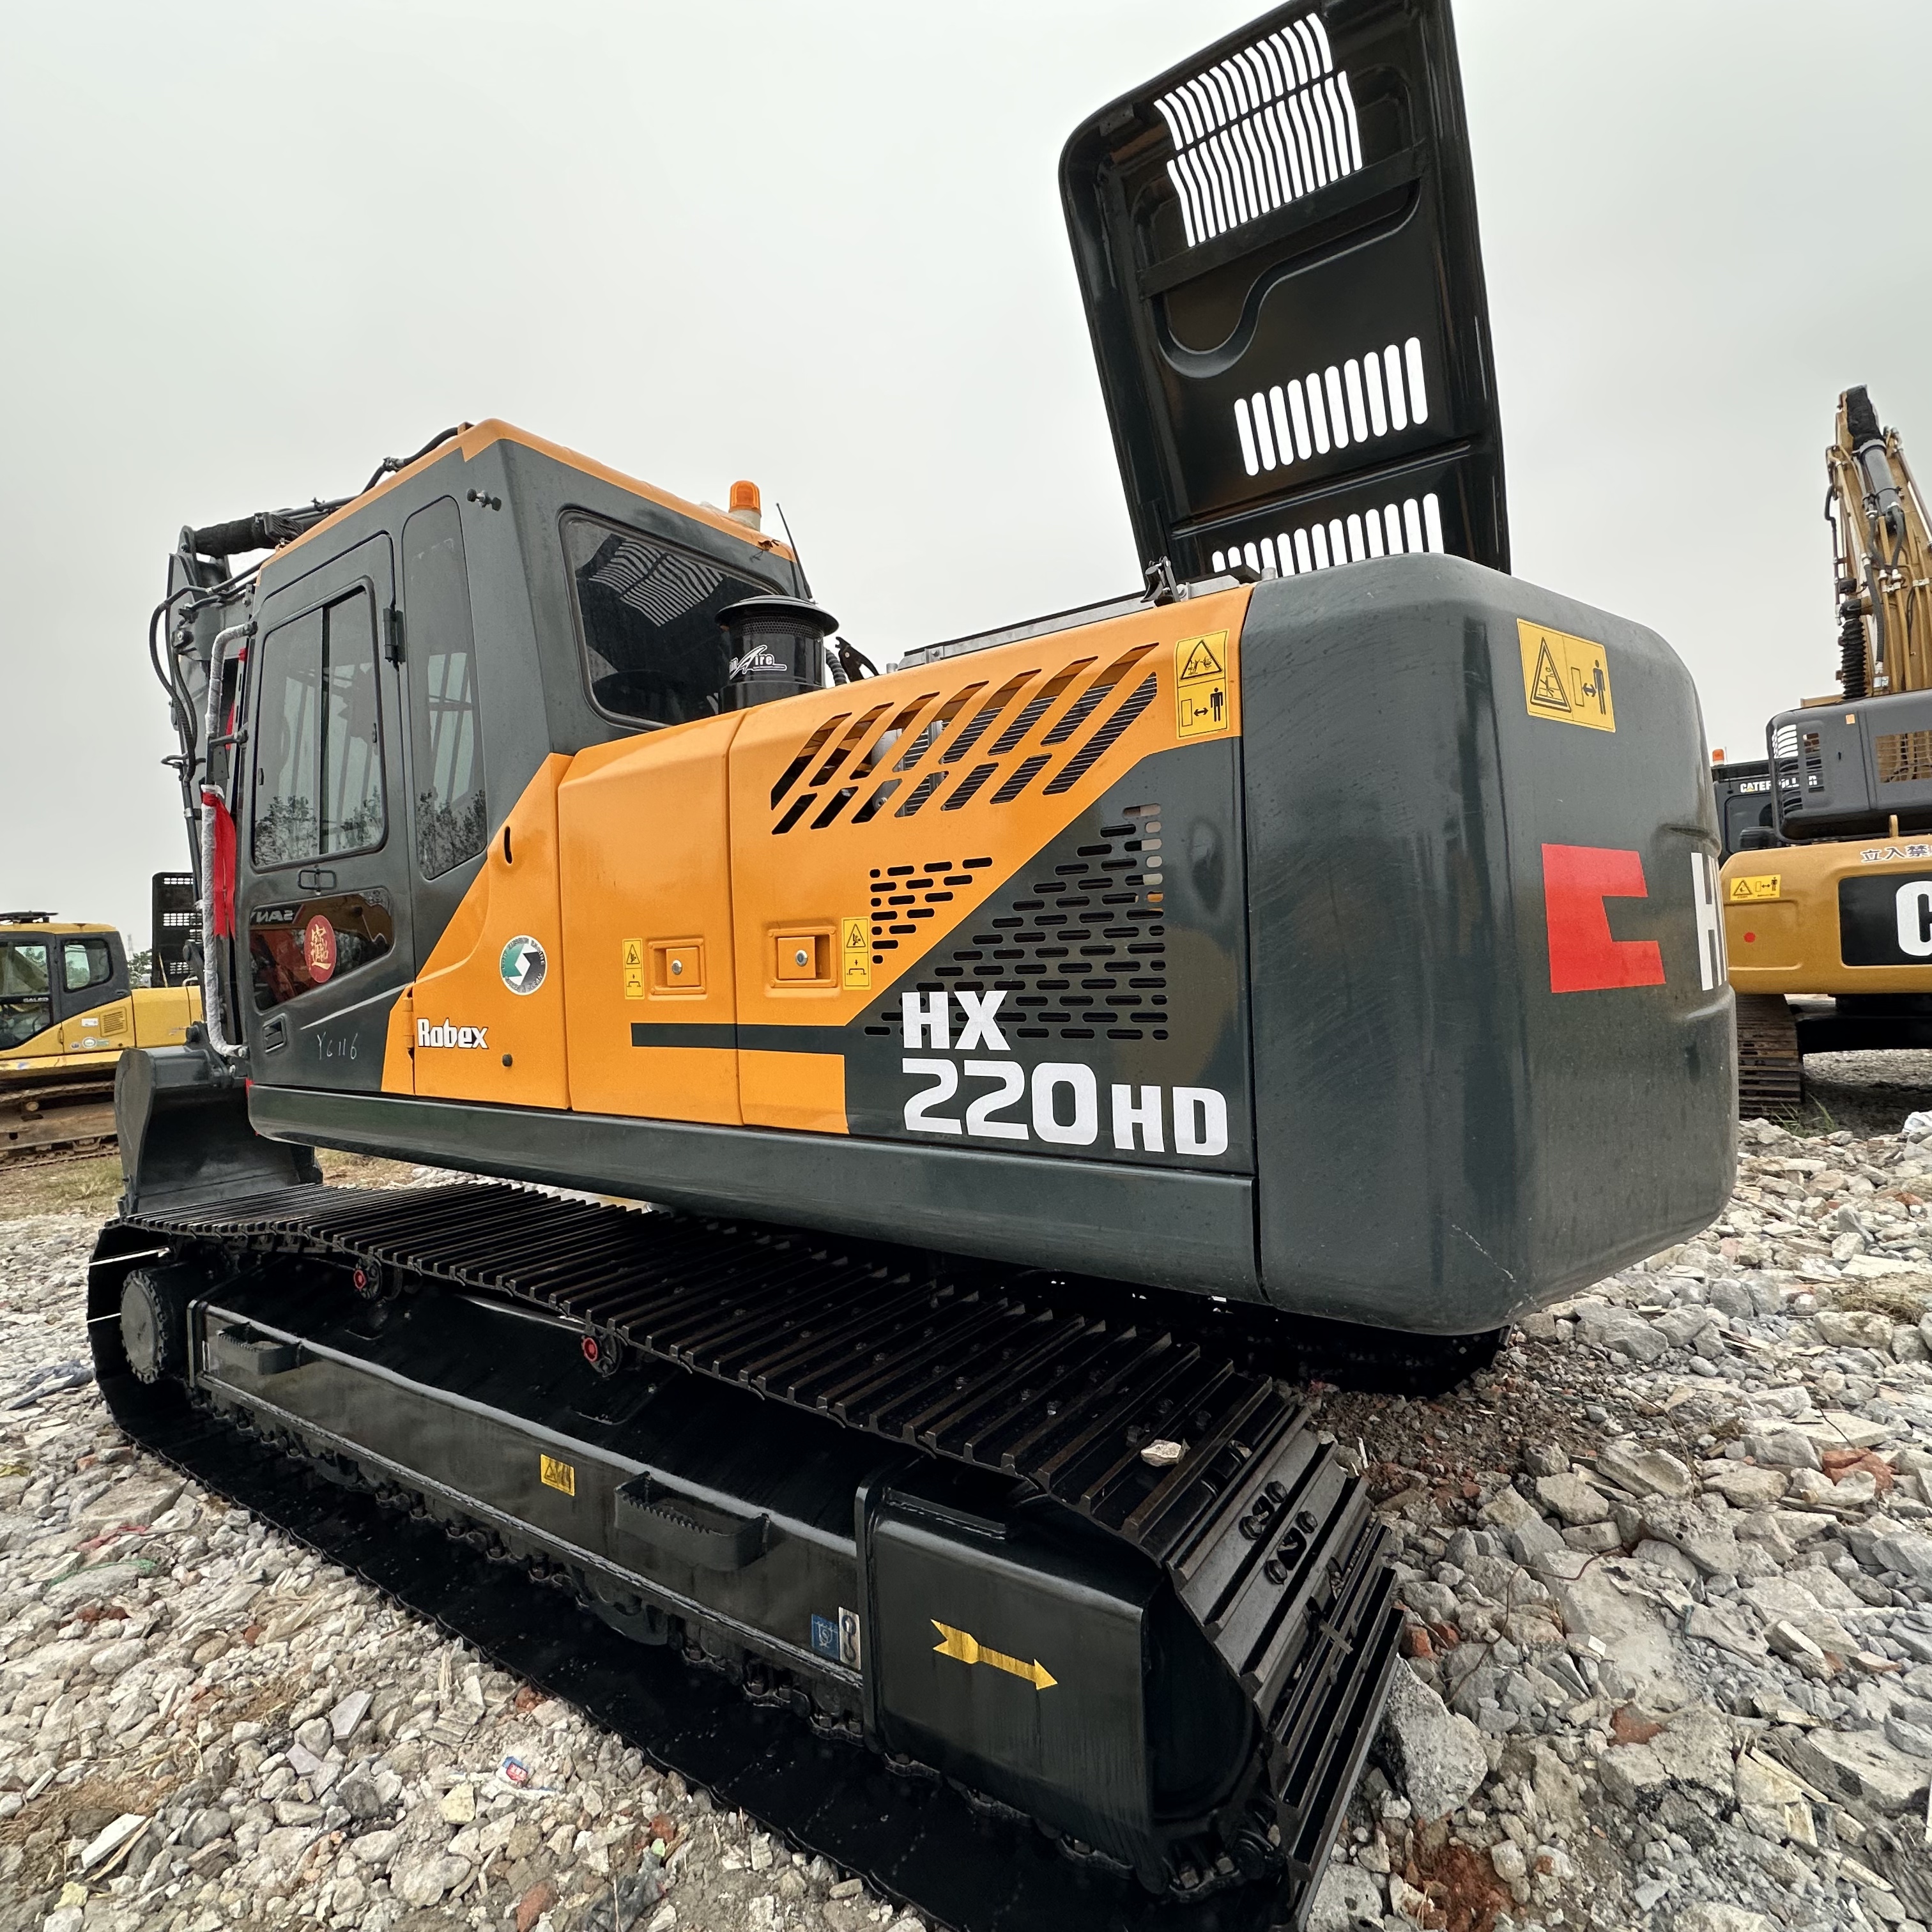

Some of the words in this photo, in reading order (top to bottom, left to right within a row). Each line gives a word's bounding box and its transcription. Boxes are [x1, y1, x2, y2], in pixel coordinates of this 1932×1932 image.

[1740, 775, 1818, 793] CATERILLR
[1860, 844, 1932, 863] 立入禁
[417, 1018, 489, 1050] Robex
[901, 990, 1011, 1051] HX
[901, 1057, 1098, 1146] 220
[1111, 1084, 1229, 1156] HD
